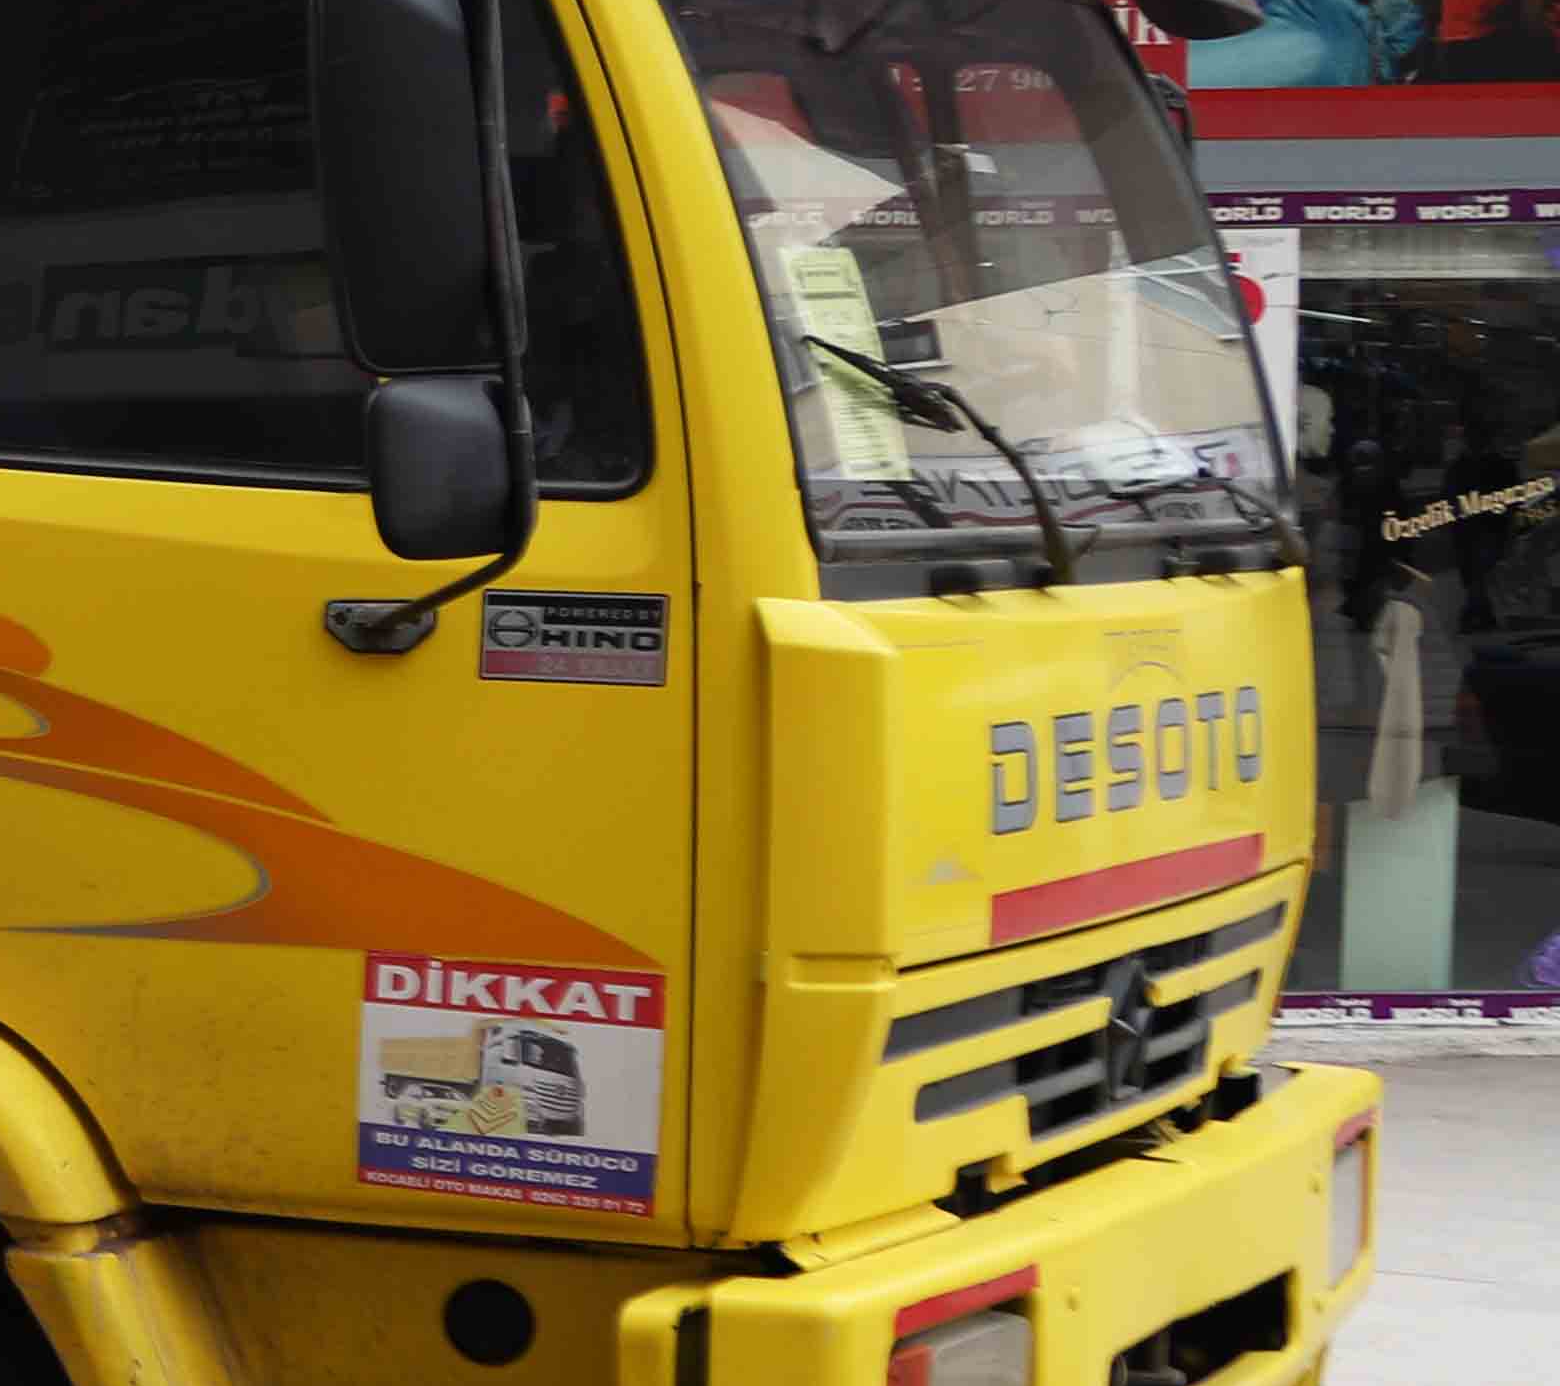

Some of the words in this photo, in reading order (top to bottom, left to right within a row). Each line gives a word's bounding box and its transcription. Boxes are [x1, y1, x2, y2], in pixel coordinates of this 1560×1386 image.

[1210, 206, 1283, 221] ORLD
[1303, 205, 1397, 221] WORLD
[1416, 203, 1511, 220] WORLD
[540, 629, 662, 651] HINO
[989, 684, 1262, 836] DESOTO
[376, 959, 651, 1021] DİKKAT
[376, 1132, 409, 1147] BU
[417, 1135, 520, 1159] ALANDA
[528, 1147, 638, 1173] SÜRÜCÜ
[412, 1156, 460, 1173] SİZİ
[470, 1163, 598, 1189] GÖREMEZ
